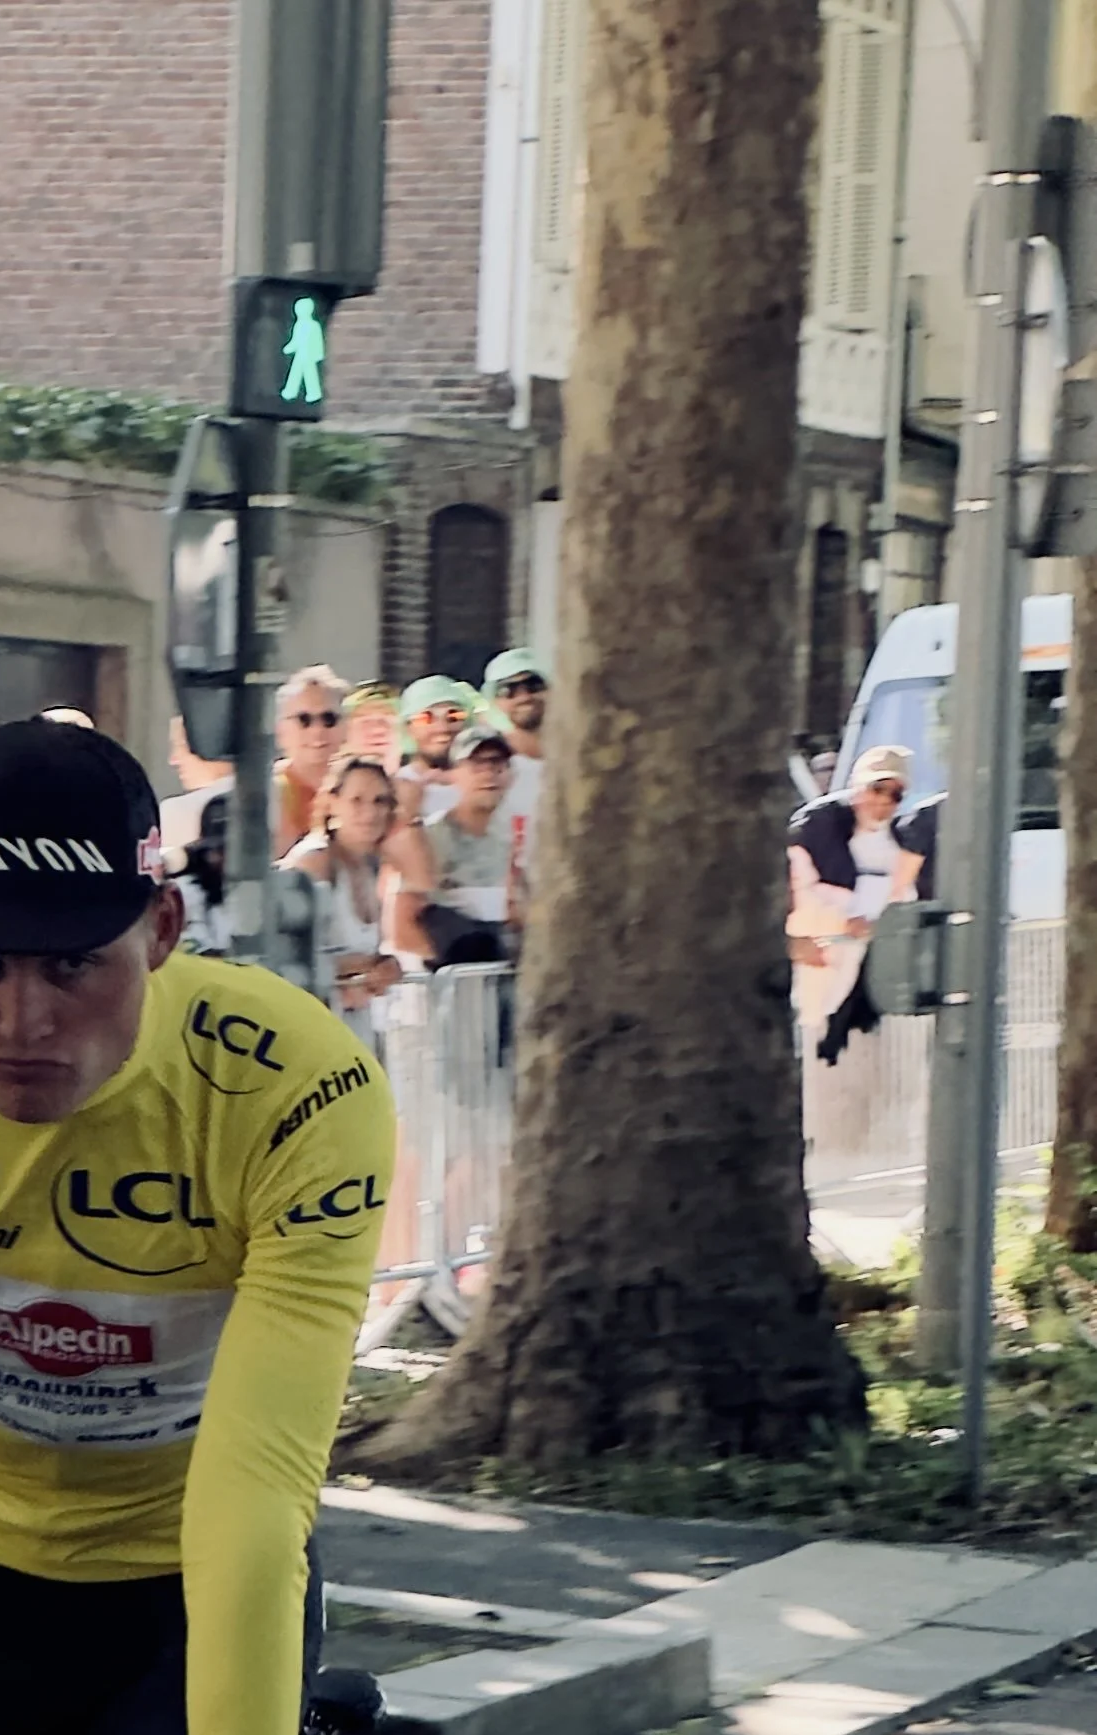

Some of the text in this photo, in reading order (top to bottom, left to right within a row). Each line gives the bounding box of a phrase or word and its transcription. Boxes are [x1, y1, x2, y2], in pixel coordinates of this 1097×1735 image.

[192, 1000, 285, 1072] LCL
[70, 1169, 216, 1228] LCL
[287, 1174, 386, 1224] LCL
